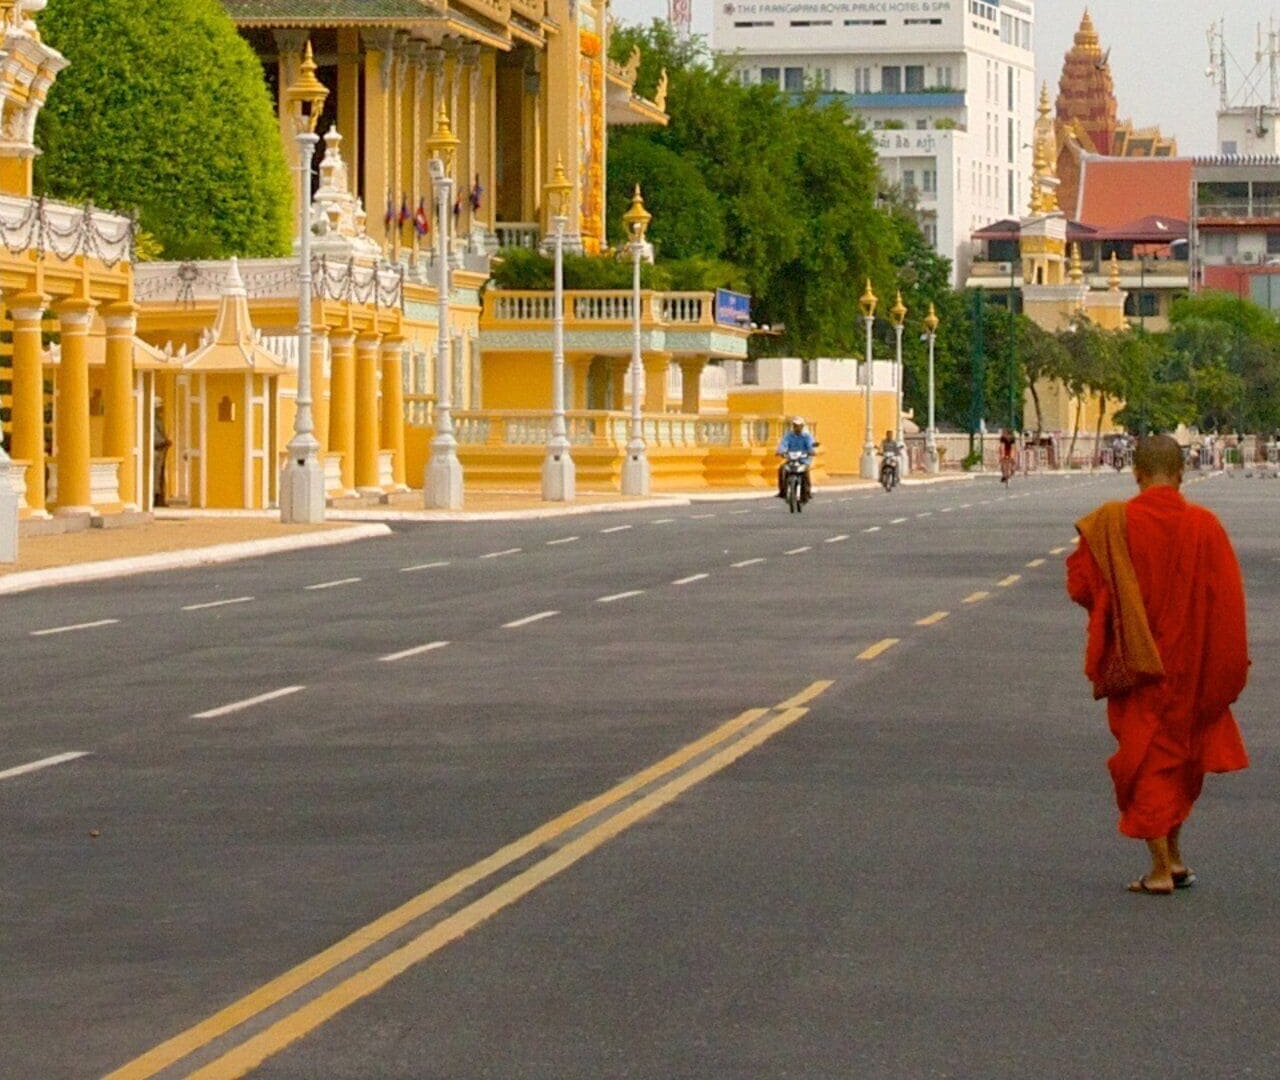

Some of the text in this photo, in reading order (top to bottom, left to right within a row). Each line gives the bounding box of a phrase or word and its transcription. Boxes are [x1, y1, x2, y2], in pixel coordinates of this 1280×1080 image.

[738, 4, 757, 14] THE
[888, 2, 920, 12] HOTEL
[932, 2, 951, 12] SPA
